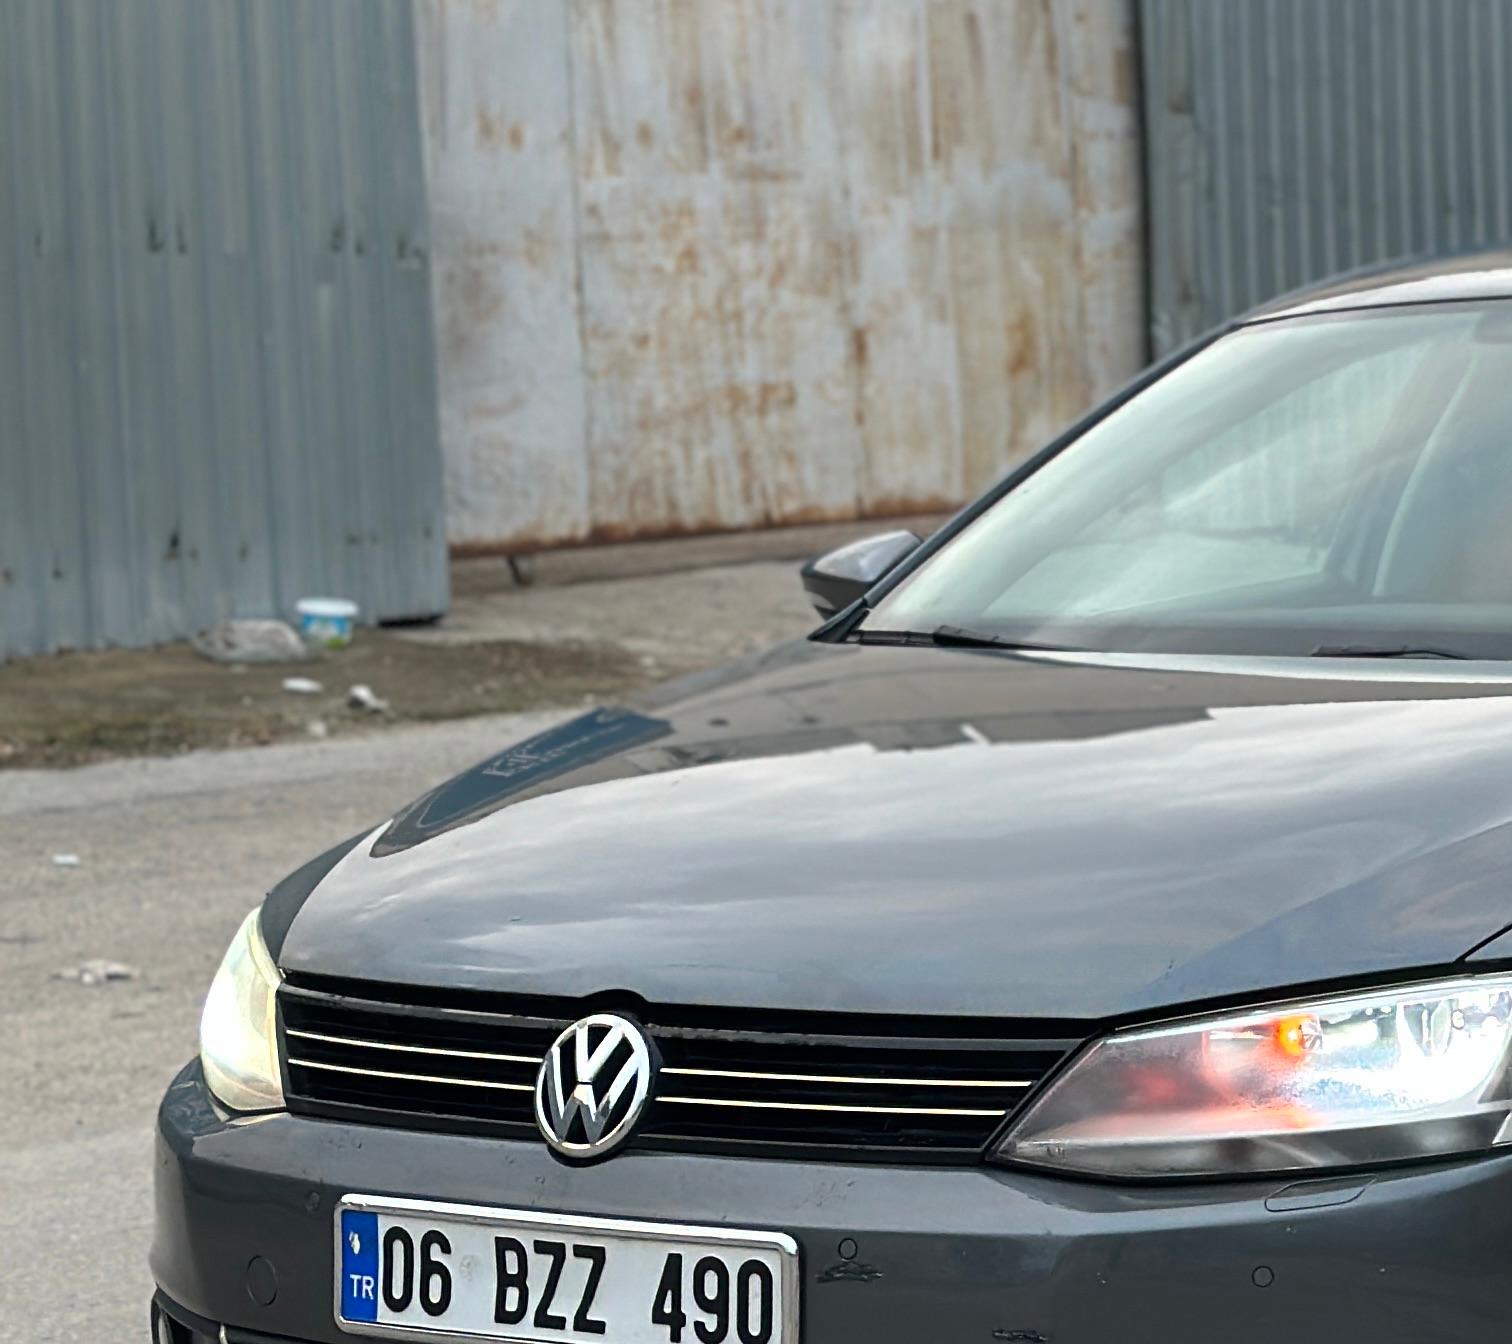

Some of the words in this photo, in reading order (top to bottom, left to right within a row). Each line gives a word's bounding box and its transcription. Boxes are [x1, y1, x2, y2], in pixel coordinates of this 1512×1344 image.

[350, 1274, 375, 1301] TR
[382, 1226, 452, 1317] 06
[494, 1236, 607, 1335] BZZ
